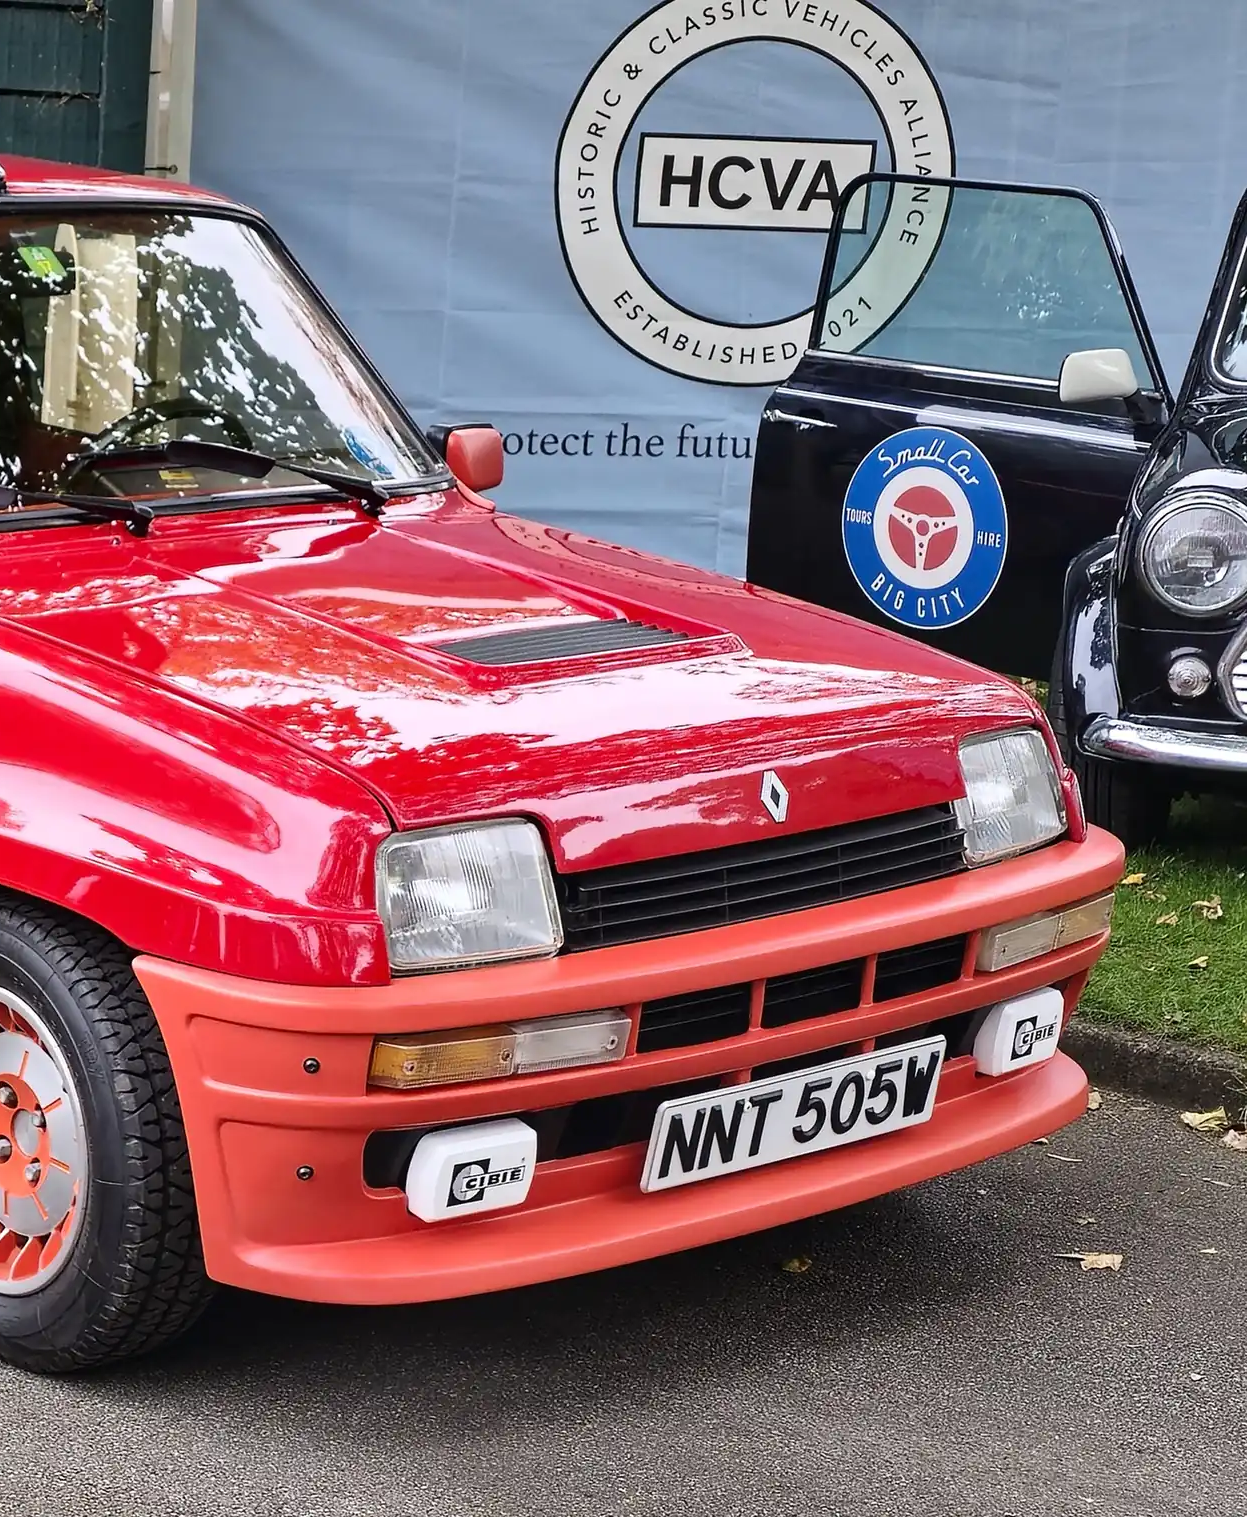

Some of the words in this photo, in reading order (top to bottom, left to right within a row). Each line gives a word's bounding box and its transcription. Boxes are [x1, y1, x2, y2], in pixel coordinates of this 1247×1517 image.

[578, 89, 621, 234] HISTORIC
[623, 63, 643, 80] &
[648, 0, 768, 55] CLASSIC
[784, 0, 904, 86] VEHICLES
[899, 99, 932, 246] ALLIANCE
[659, 154, 841, 212] HCVA
[613, 290, 798, 365] ESTABLISHED
[813, 296, 872, 352] 021
[499, 429, 594, 457] otect
[605, 422, 664, 457] the
[676, 423, 753, 459] futu
[878, 438, 946, 478] Small
[947, 449, 980, 486] Car
[846, 507, 873, 525] TOURS
[976, 530, 1002, 548] HIRE
[870, 572, 905, 610] BIG
[917, 587, 965, 618] CITY
[657, 1089, 783, 1179] NNT
[791, 1050, 940, 1144] 505W
